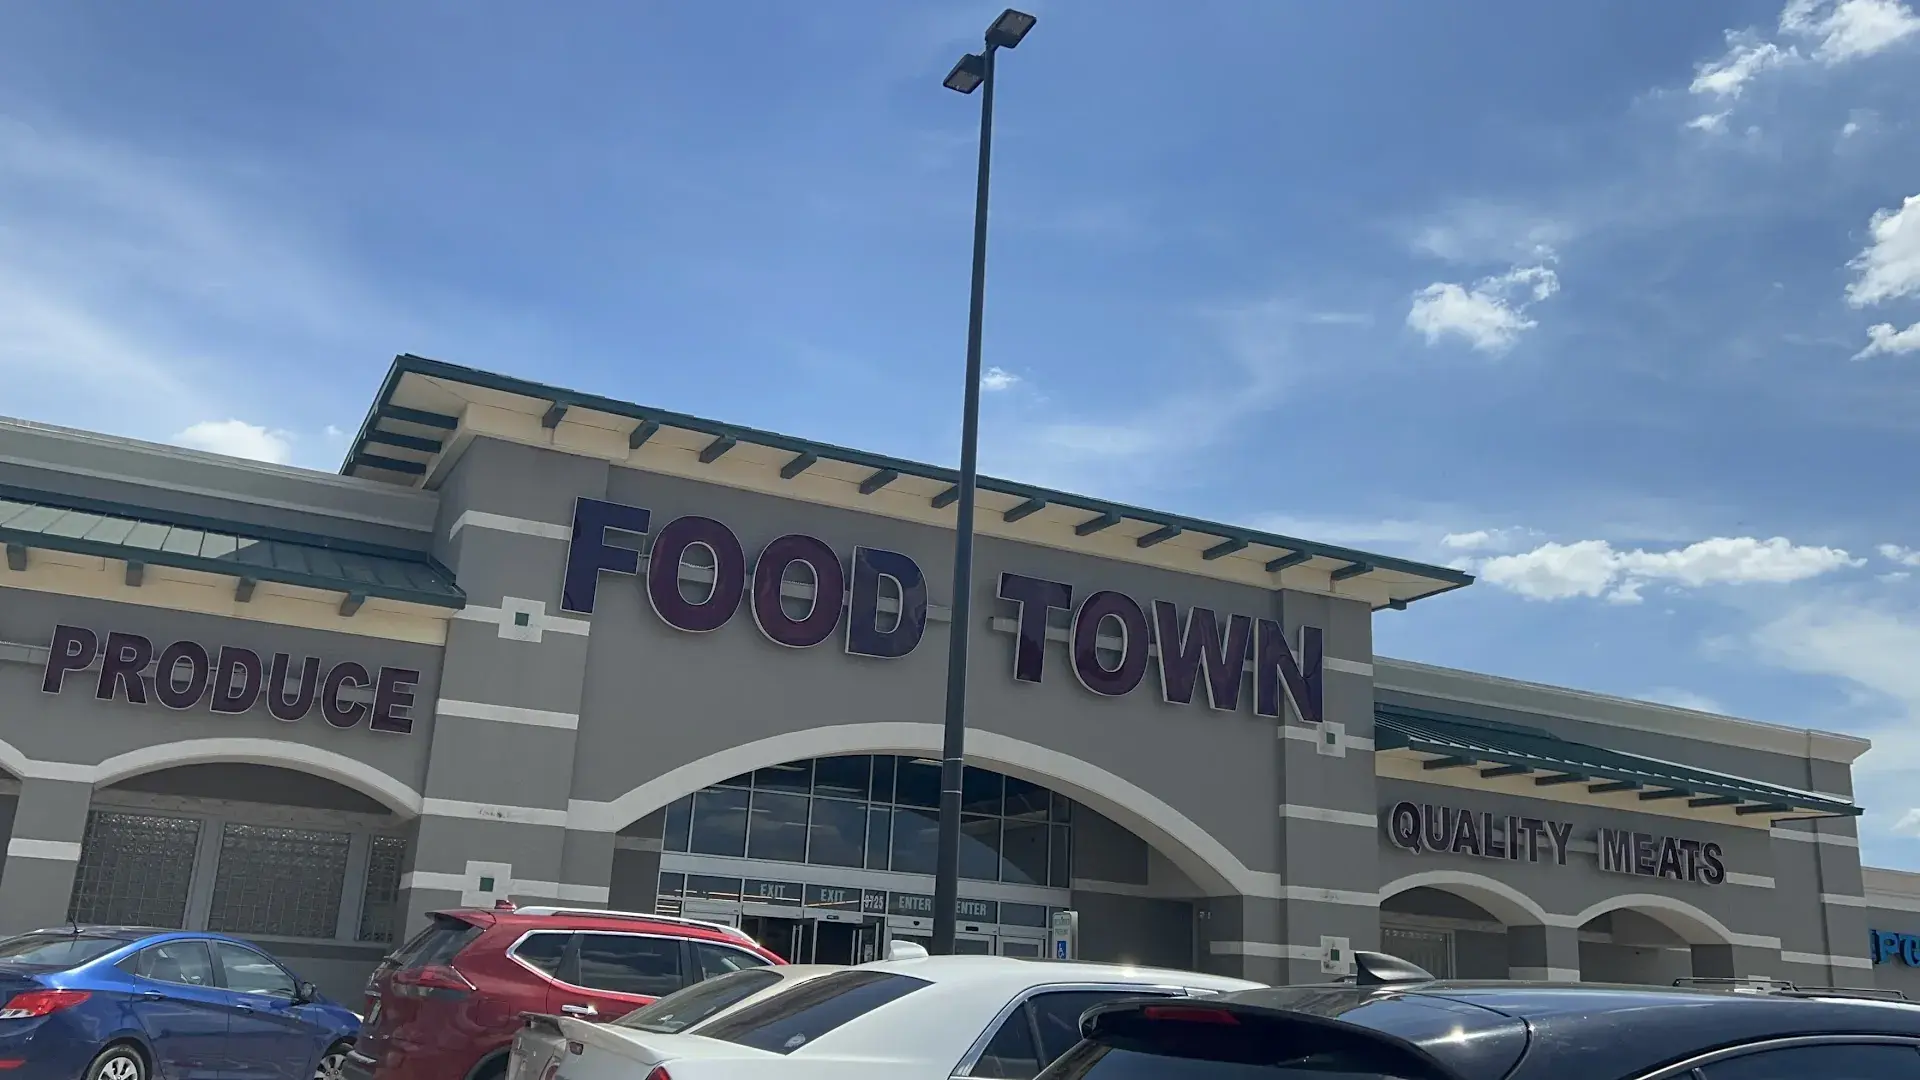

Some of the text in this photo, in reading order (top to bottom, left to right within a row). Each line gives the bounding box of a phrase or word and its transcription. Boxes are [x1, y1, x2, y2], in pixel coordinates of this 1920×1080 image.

[560, 496, 1323, 723] FOOD TOWN
[41, 624, 420, 735] PRODUCE
[1388, 801, 1725, 885] QUALITY MEATS
[760, 884, 786, 898] EXIT
[820, 888, 845, 902] EXIT
[899, 895, 932, 912] ENTER
[956, 901, 987, 916] ENTER
